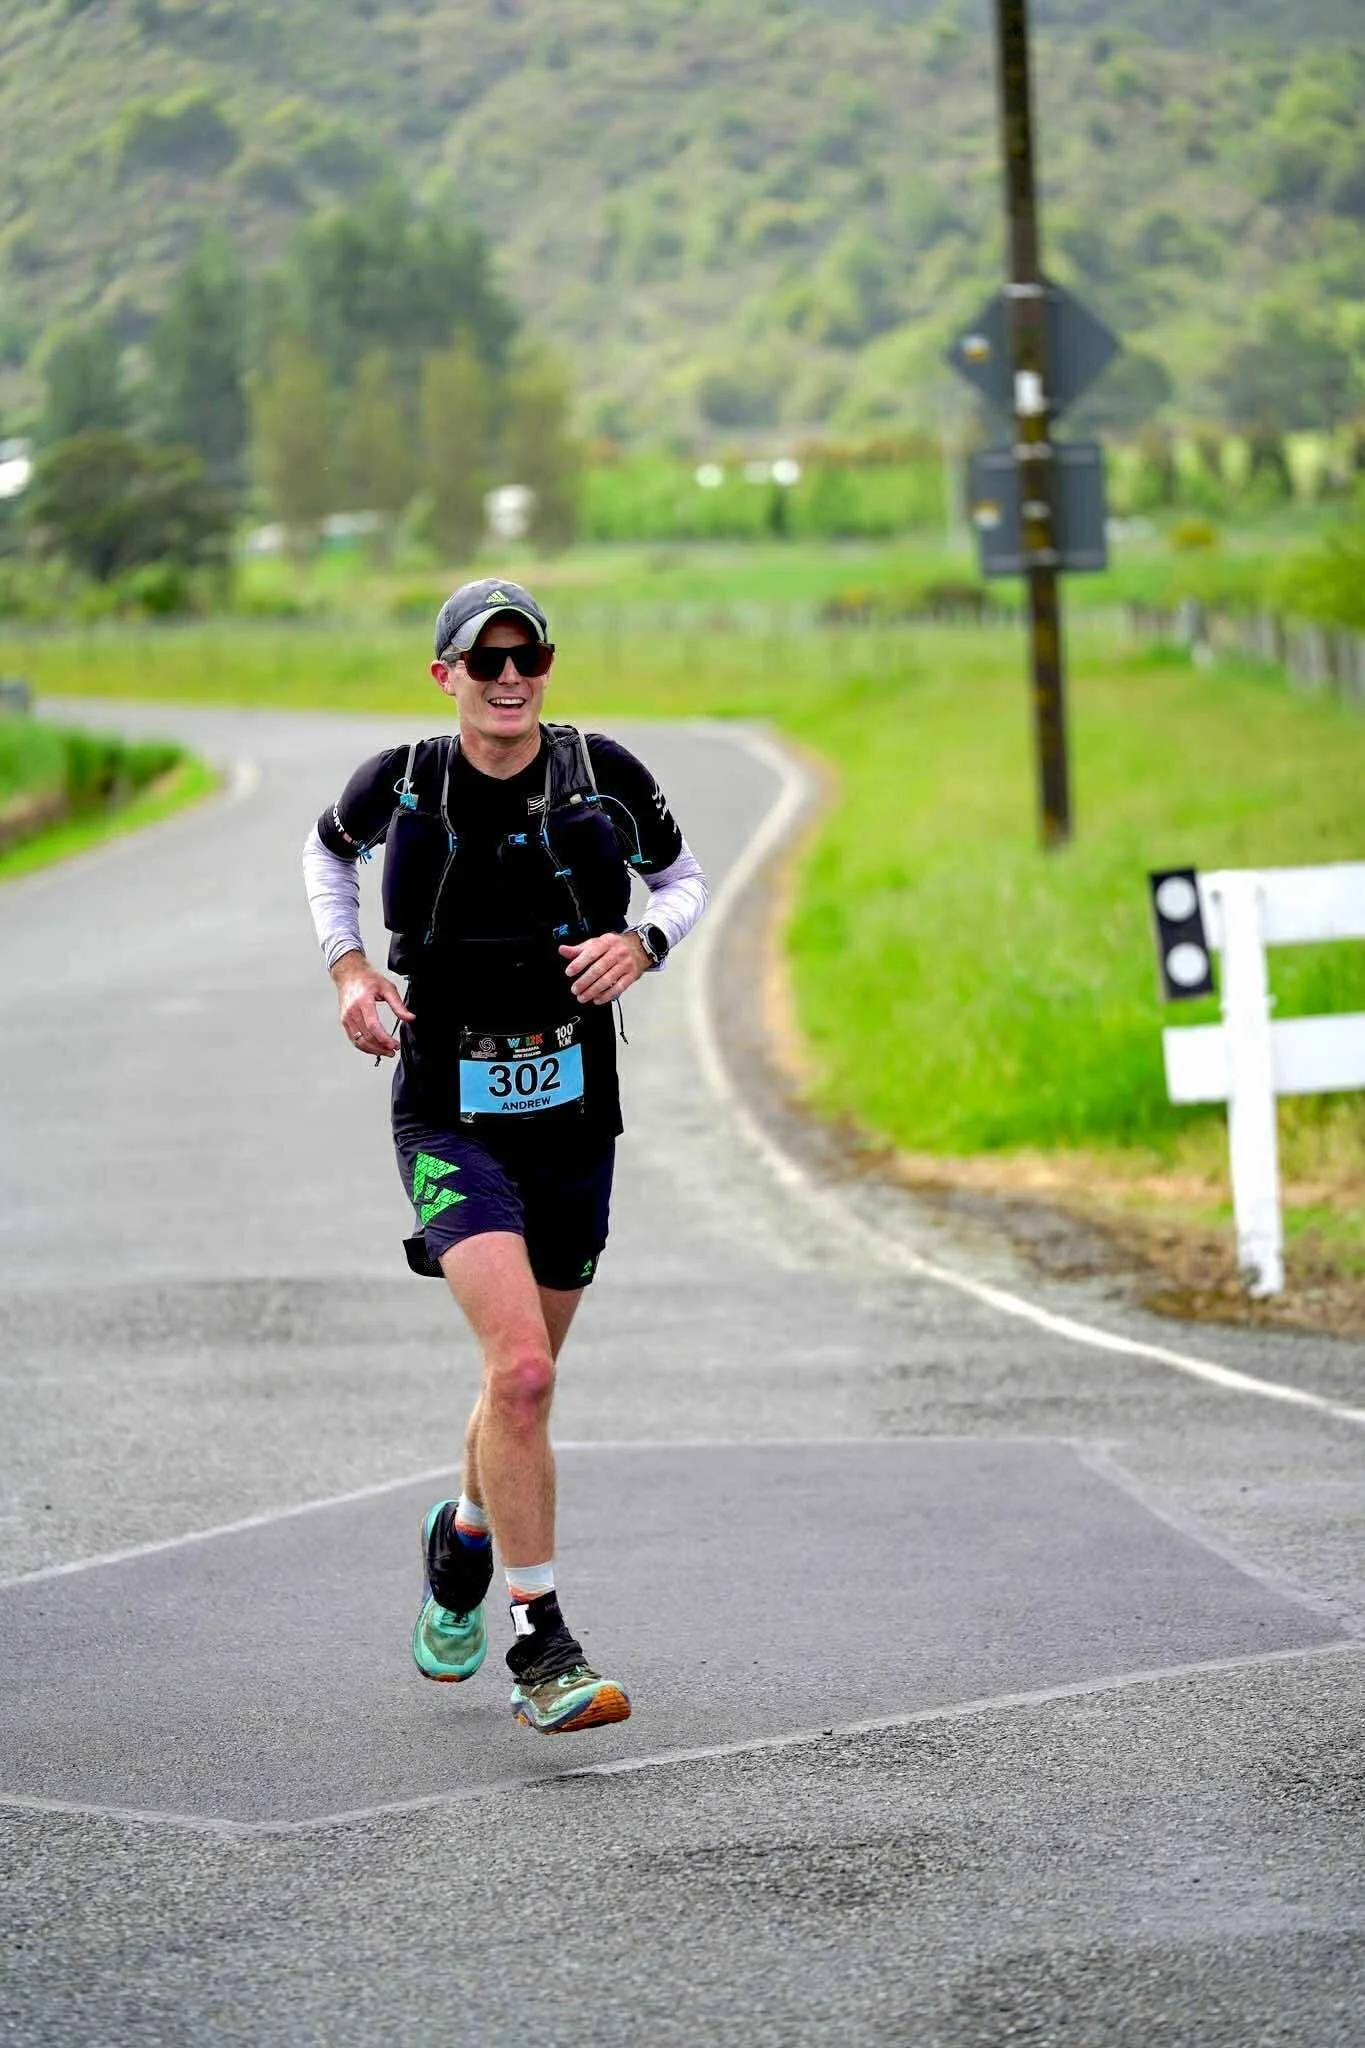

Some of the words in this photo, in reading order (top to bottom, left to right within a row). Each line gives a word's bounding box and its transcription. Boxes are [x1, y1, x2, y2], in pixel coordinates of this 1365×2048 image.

[554, 1023, 574, 1040] 100
[558, 1036, 572, 1048] KM
[488, 1057, 561, 1098] 302
[501, 1096, 552, 1111] ANDREW
